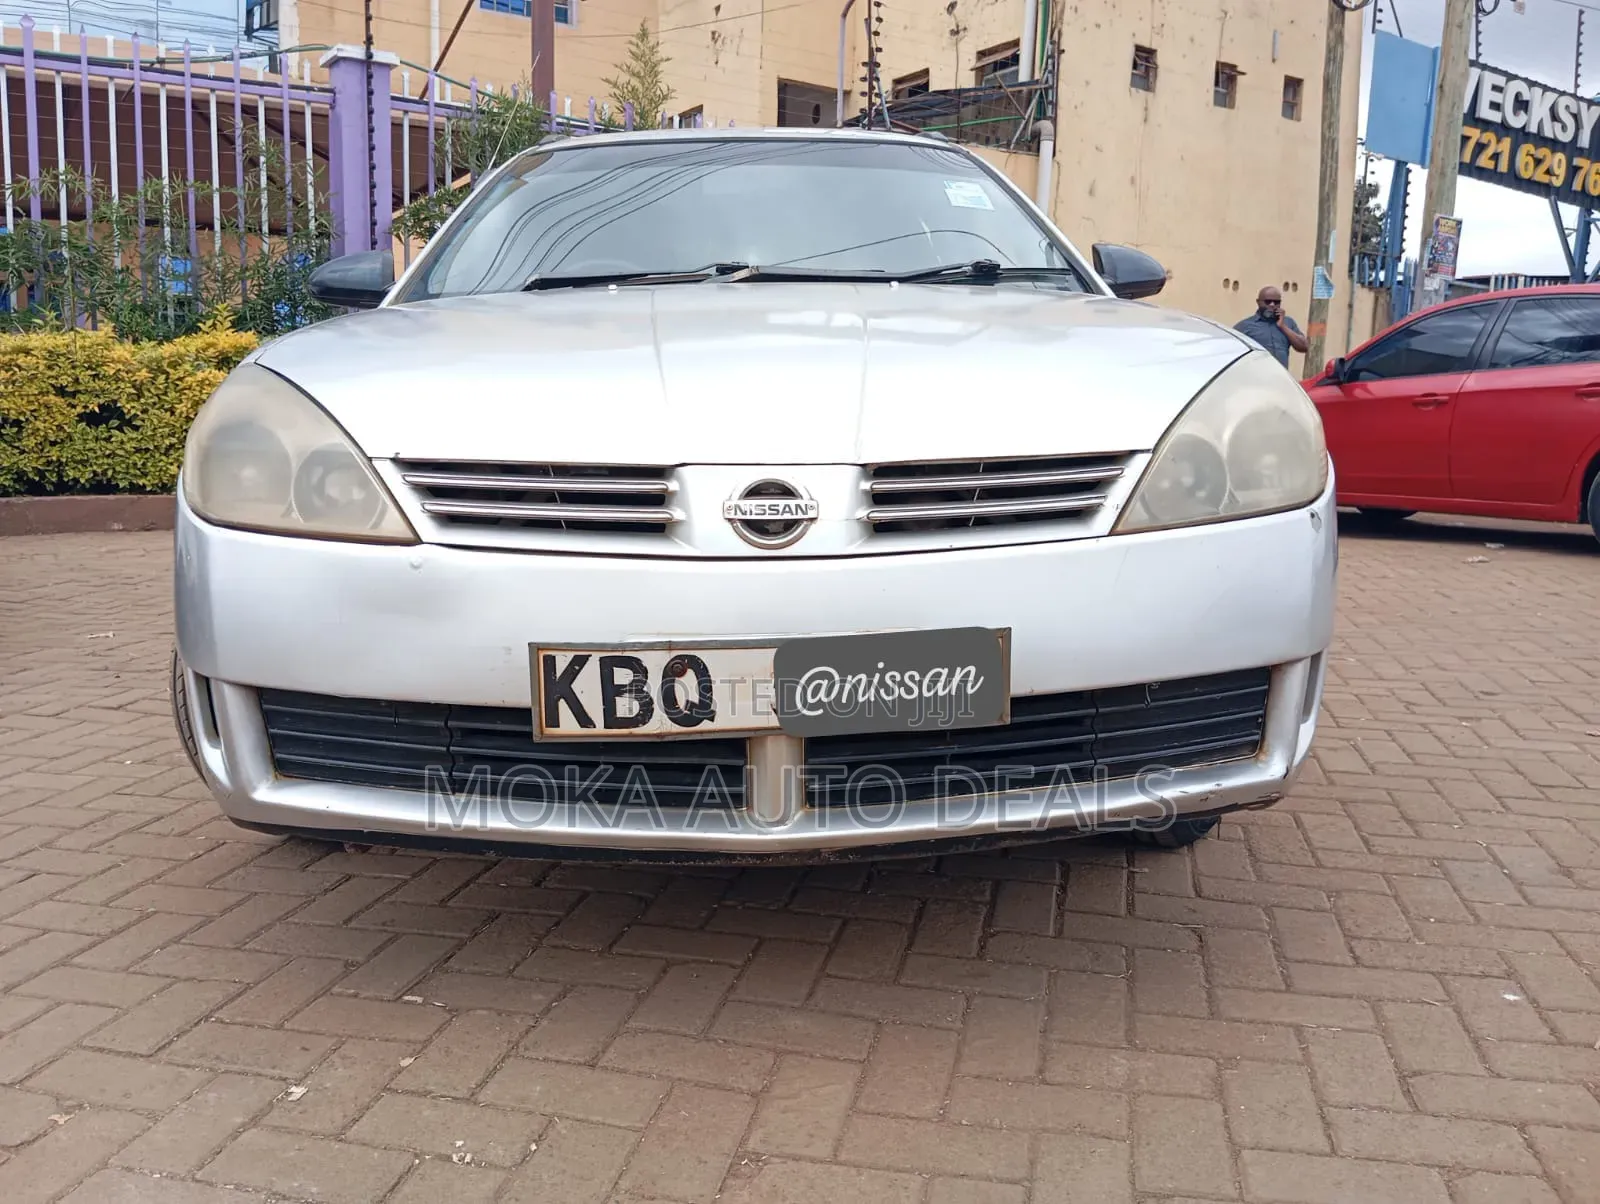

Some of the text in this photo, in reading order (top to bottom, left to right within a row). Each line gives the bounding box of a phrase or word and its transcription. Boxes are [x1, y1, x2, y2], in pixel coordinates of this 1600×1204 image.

[1515, 143, 1566, 187] 629
[733, 503, 809, 516] NISSAN
[542, 653, 717, 730] KBQ
